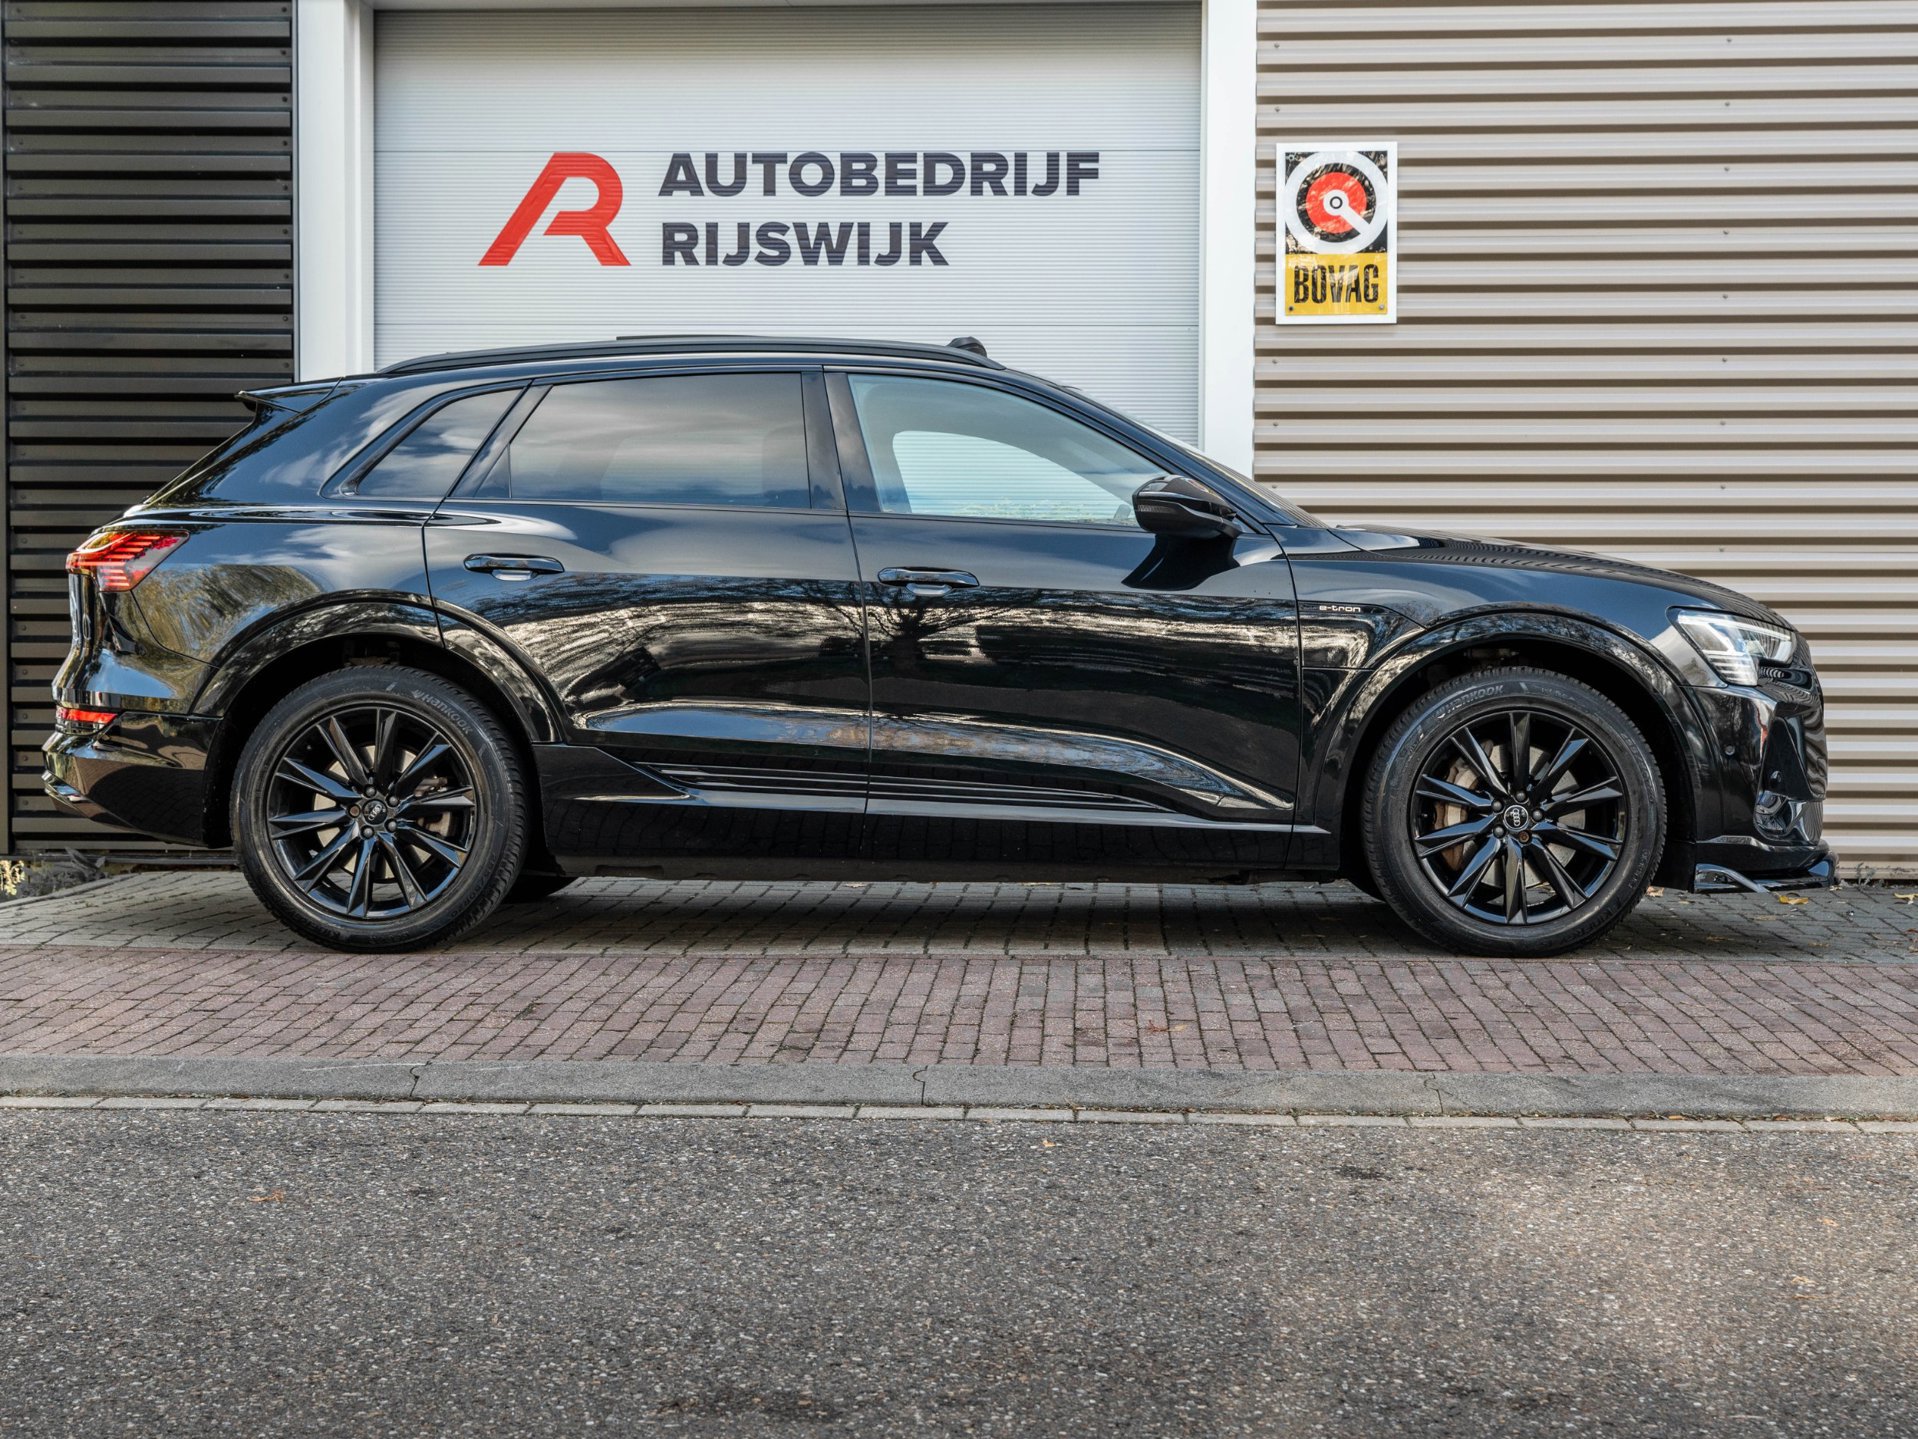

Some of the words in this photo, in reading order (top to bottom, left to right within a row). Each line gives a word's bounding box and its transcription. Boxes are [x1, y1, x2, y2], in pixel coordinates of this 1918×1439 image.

[659, 151, 1100, 197] AUTOBEDRIJF
[662, 221, 950, 267] RIJSWIJK
[1294, 264, 1379, 304] BOVAG
[1319, 605, 1361, 613] e-tron
